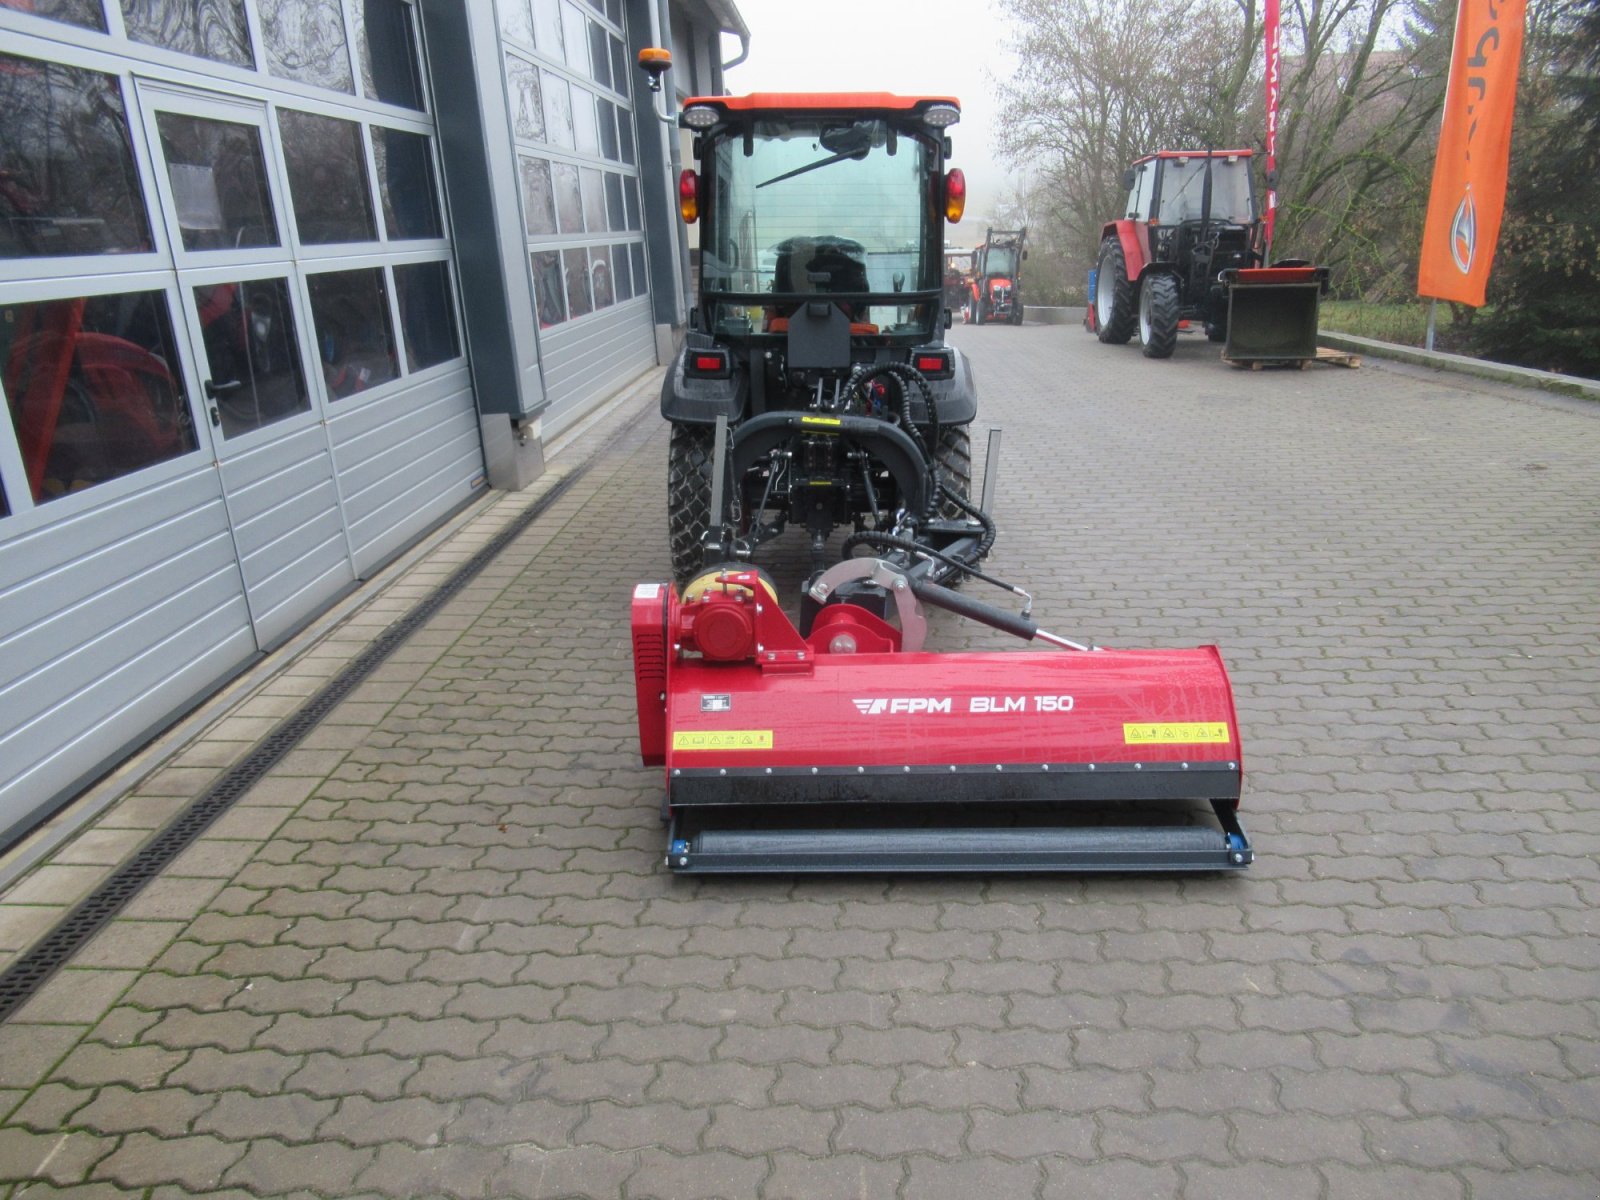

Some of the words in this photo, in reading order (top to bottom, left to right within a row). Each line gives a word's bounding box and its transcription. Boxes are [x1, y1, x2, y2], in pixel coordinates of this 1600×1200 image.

[890, 697, 952, 715] FPM
[969, 696, 1026, 713] BLM
[1034, 695, 1074, 712] 150
